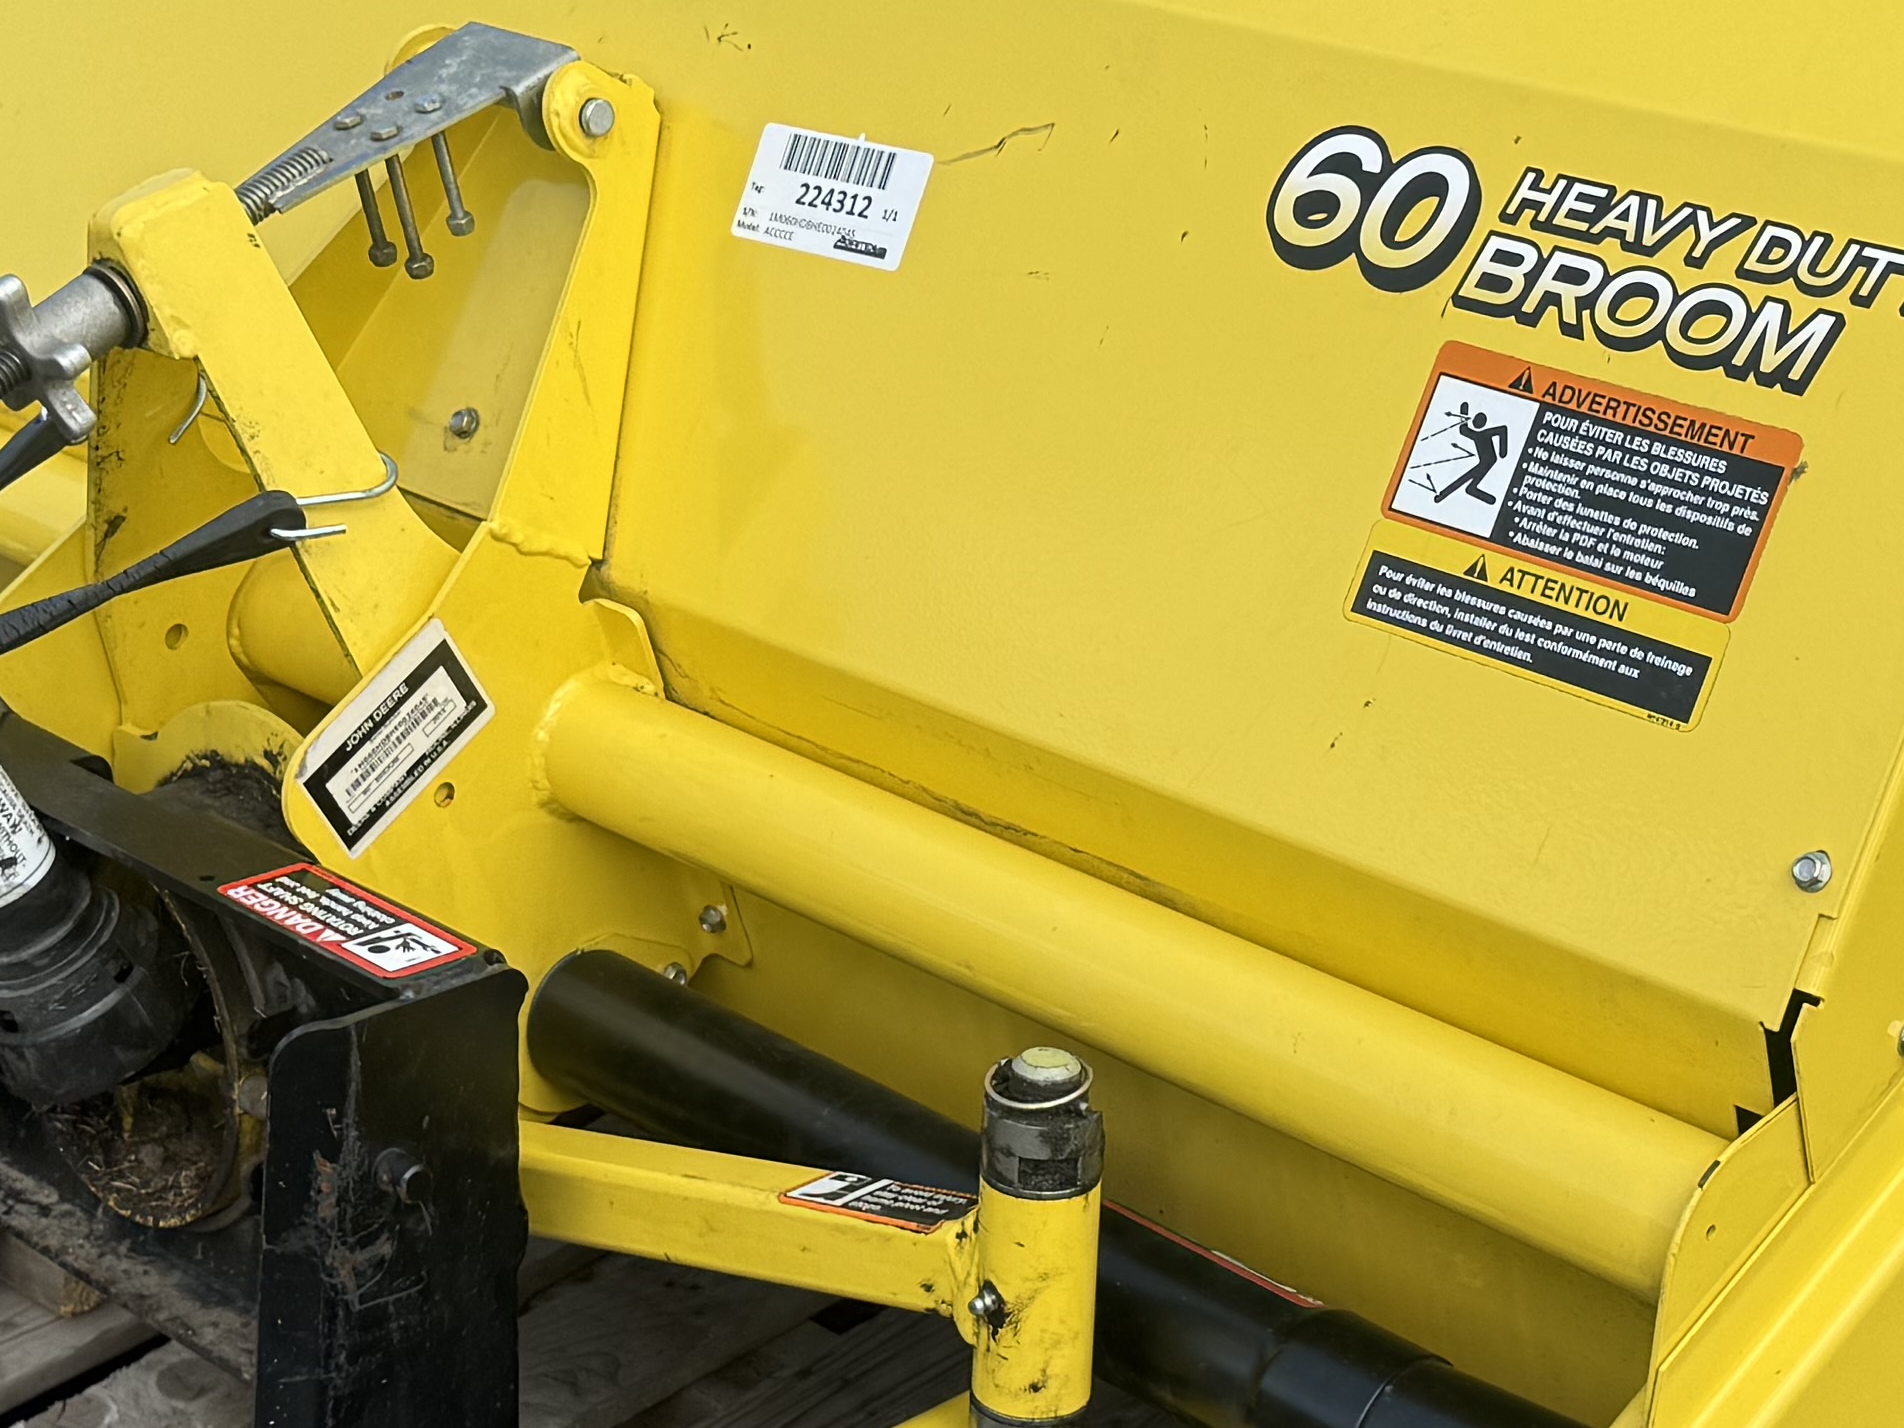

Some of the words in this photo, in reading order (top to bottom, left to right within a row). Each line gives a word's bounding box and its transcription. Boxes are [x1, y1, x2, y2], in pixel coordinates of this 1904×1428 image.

[794, 181, 874, 219] 224312
[880, 207, 899, 224] 1/1
[1266, 125, 1481, 293] 60
[1499, 166, 1753, 269] HEAVY
[1452, 229, 1848, 397] BROOM
[1540, 379, 1756, 456] ADVERTISSEMENT
[1541, 410, 1580, 433] POUR
[1578, 418, 1626, 446] ÉVITER
[1623, 433, 1651, 453] LES
[1649, 440, 1729, 475] BLESSURES
[1521, 473, 1583, 502] protection.
[1534, 426, 1595, 457] CAUSÉES
[1593, 445, 1624, 465] PAR
[1622, 453, 1650, 472] LES
[1648, 460, 1701, 487] OBJETS
[1699, 472, 1771, 506] PROJETÉS
[1512, 499, 1547, 519] Avant
[1517, 485, 1553, 506] Porter
[1637, 522, 1701, 551] protection.
[1637, 477, 1706, 508] s'approcher
[1704, 496, 1731, 516] trop
[1570, 532, 1596, 550] PDF
[1621, 549, 1664, 571] moteur
[1735, 522, 1754, 537] de
[1377, 564, 1405, 583] Pour
[1497, 564, 1631, 622] ATTENTION
[1603, 561, 1624, 576] sur
[1616, 662, 1641, 679] aux
[342, 717, 374, 752] JOHN
[372, 681, 409, 722] DEERE
[225, 885, 323, 942] DANGER
